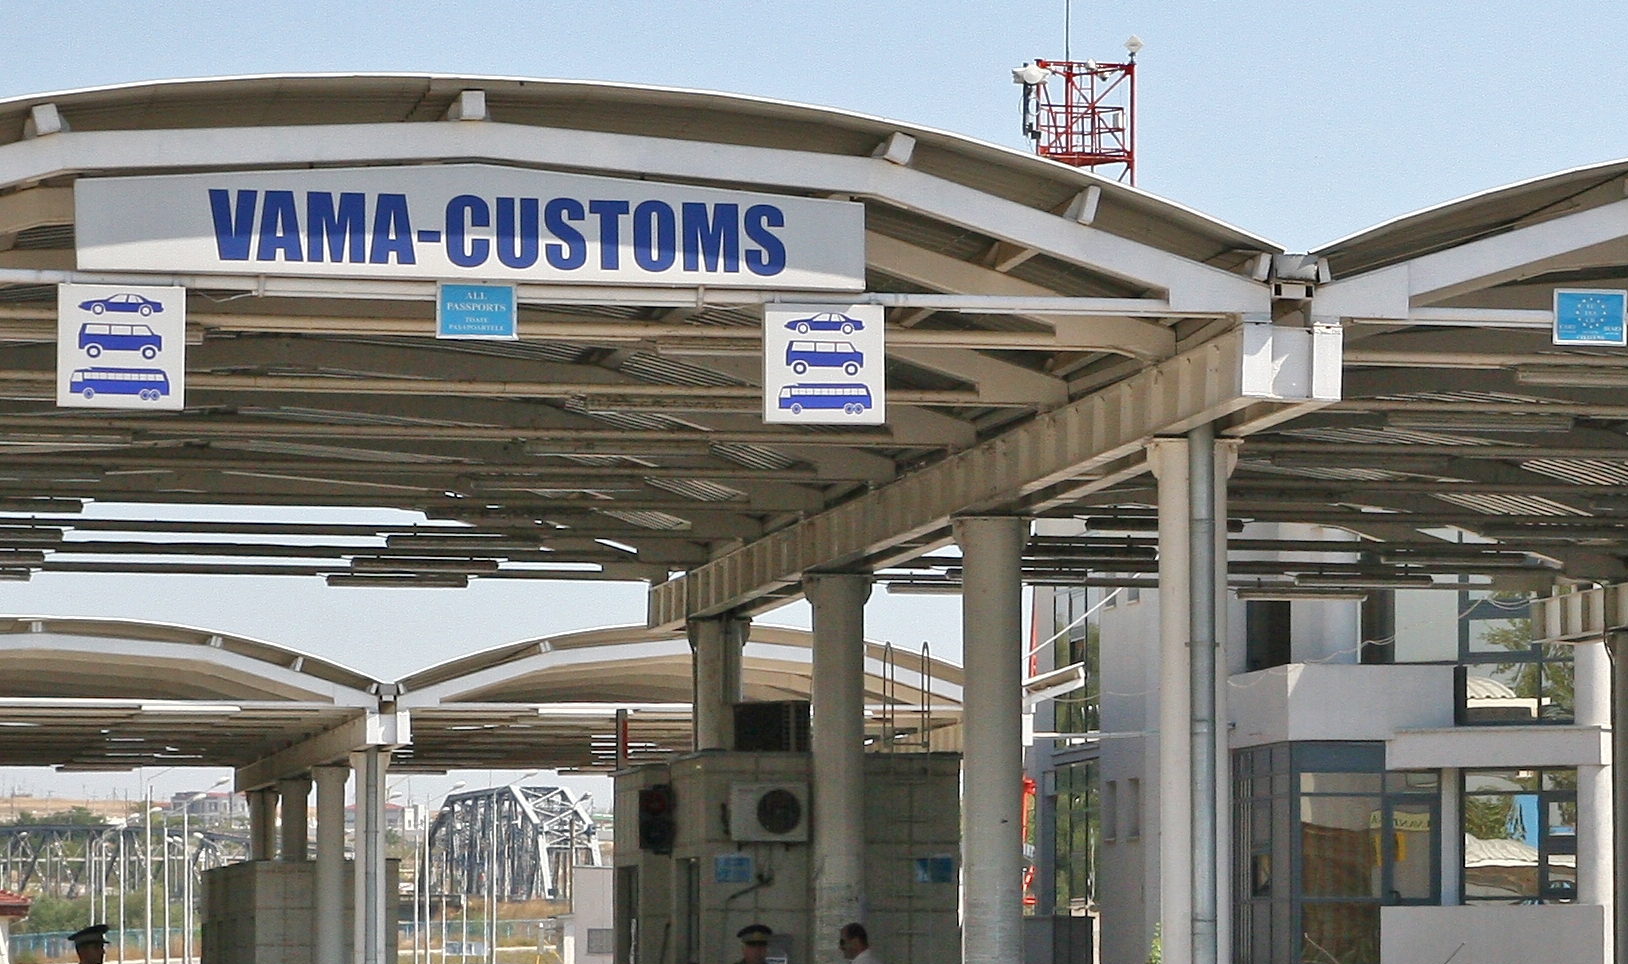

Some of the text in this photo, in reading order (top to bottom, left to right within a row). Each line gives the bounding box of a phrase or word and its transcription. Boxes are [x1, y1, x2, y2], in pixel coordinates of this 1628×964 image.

[208, 188, 787, 276] VAMA-CUSTOMS
[466, 292, 487, 300] ALL
[447, 302, 506, 312] PASSPORTS
